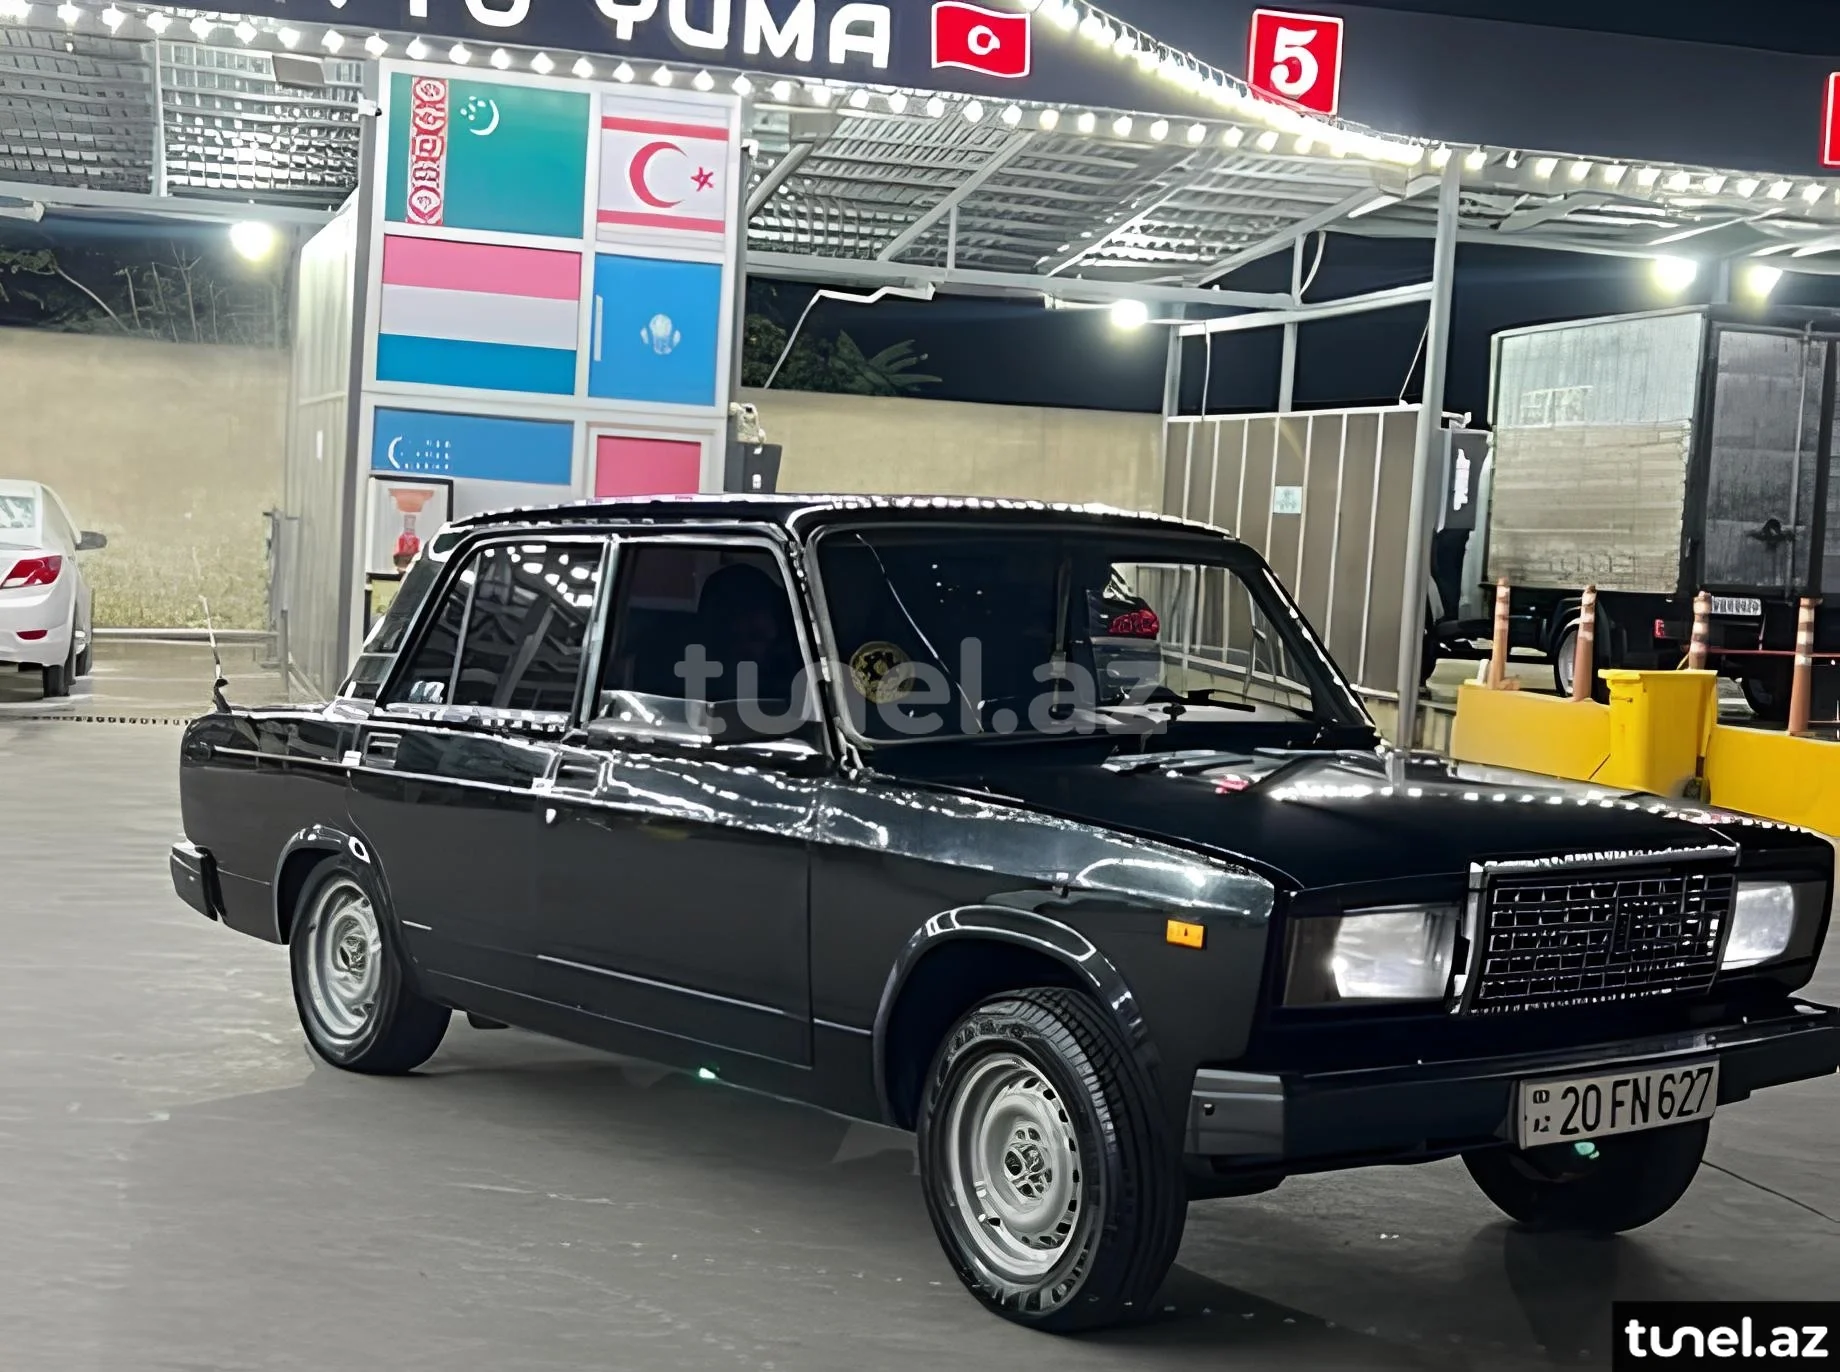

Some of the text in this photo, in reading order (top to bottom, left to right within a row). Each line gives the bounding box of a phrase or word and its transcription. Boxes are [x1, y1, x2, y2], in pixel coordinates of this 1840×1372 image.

[1269, 26, 1319, 99] 5
[1560, 1066, 1714, 1135] 20 FN 627
